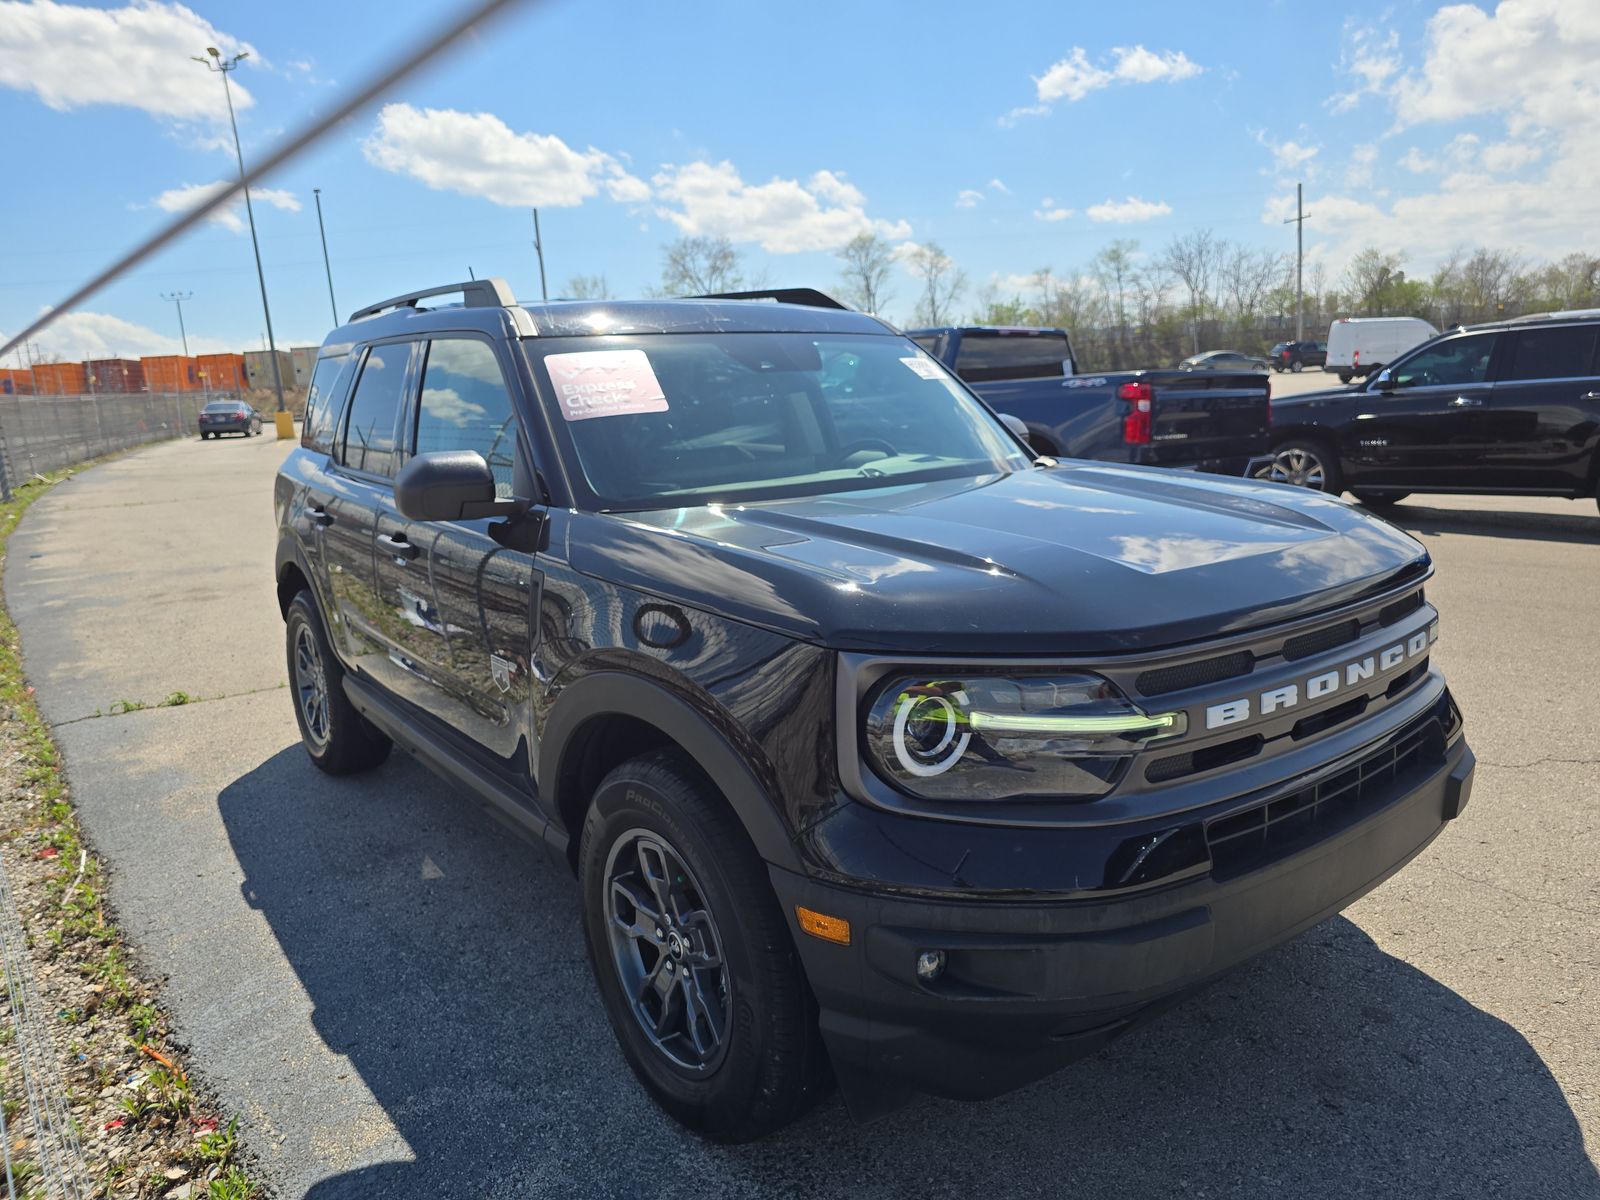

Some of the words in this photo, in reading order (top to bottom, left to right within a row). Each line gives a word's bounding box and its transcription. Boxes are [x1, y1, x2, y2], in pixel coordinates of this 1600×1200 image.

[561, 379, 637, 396] Express
[566, 391, 625, 408] Check
[1206, 631, 1427, 730] BRONCO
